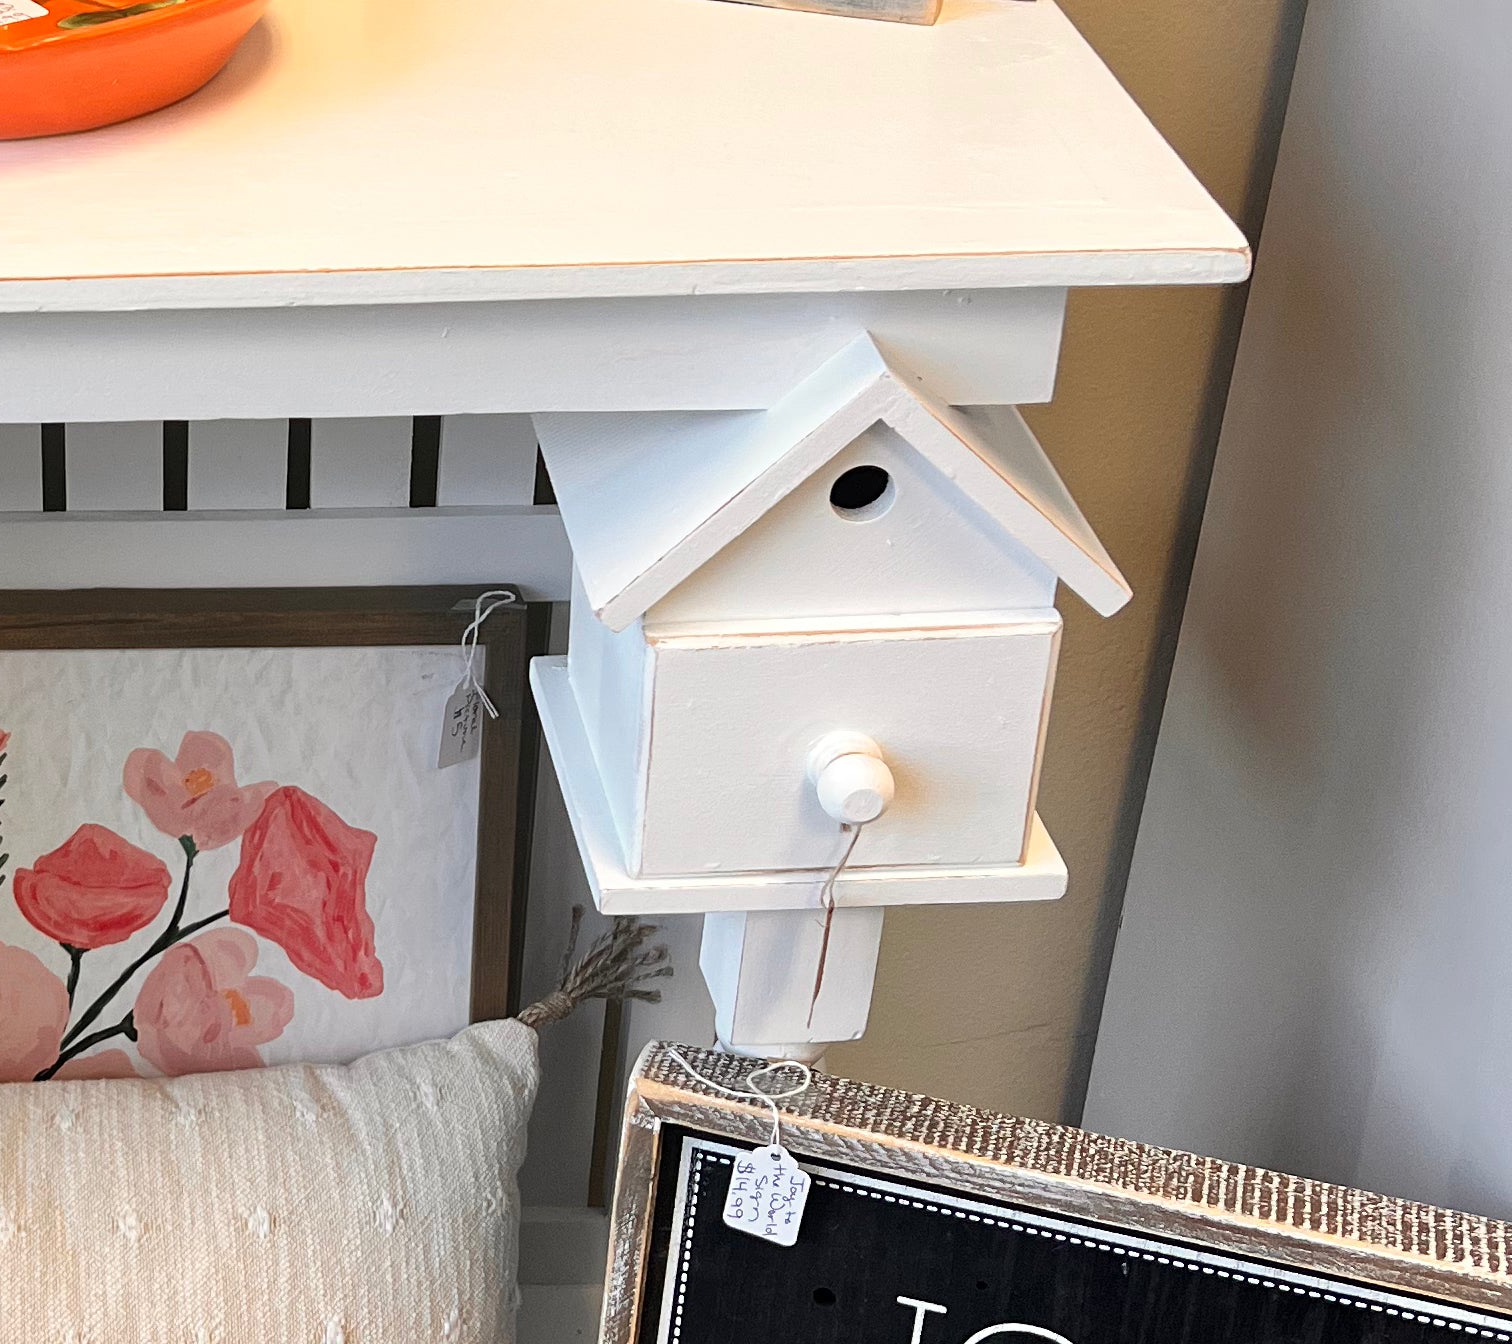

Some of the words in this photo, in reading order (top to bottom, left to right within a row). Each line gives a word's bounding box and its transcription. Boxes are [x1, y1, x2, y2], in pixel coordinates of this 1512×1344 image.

[727, 1160, 756, 1219] $14.99
[748, 1175, 768, 1222] Sign
[782, 1176, 805, 1208] Joy
[762, 1193, 786, 1235] World
